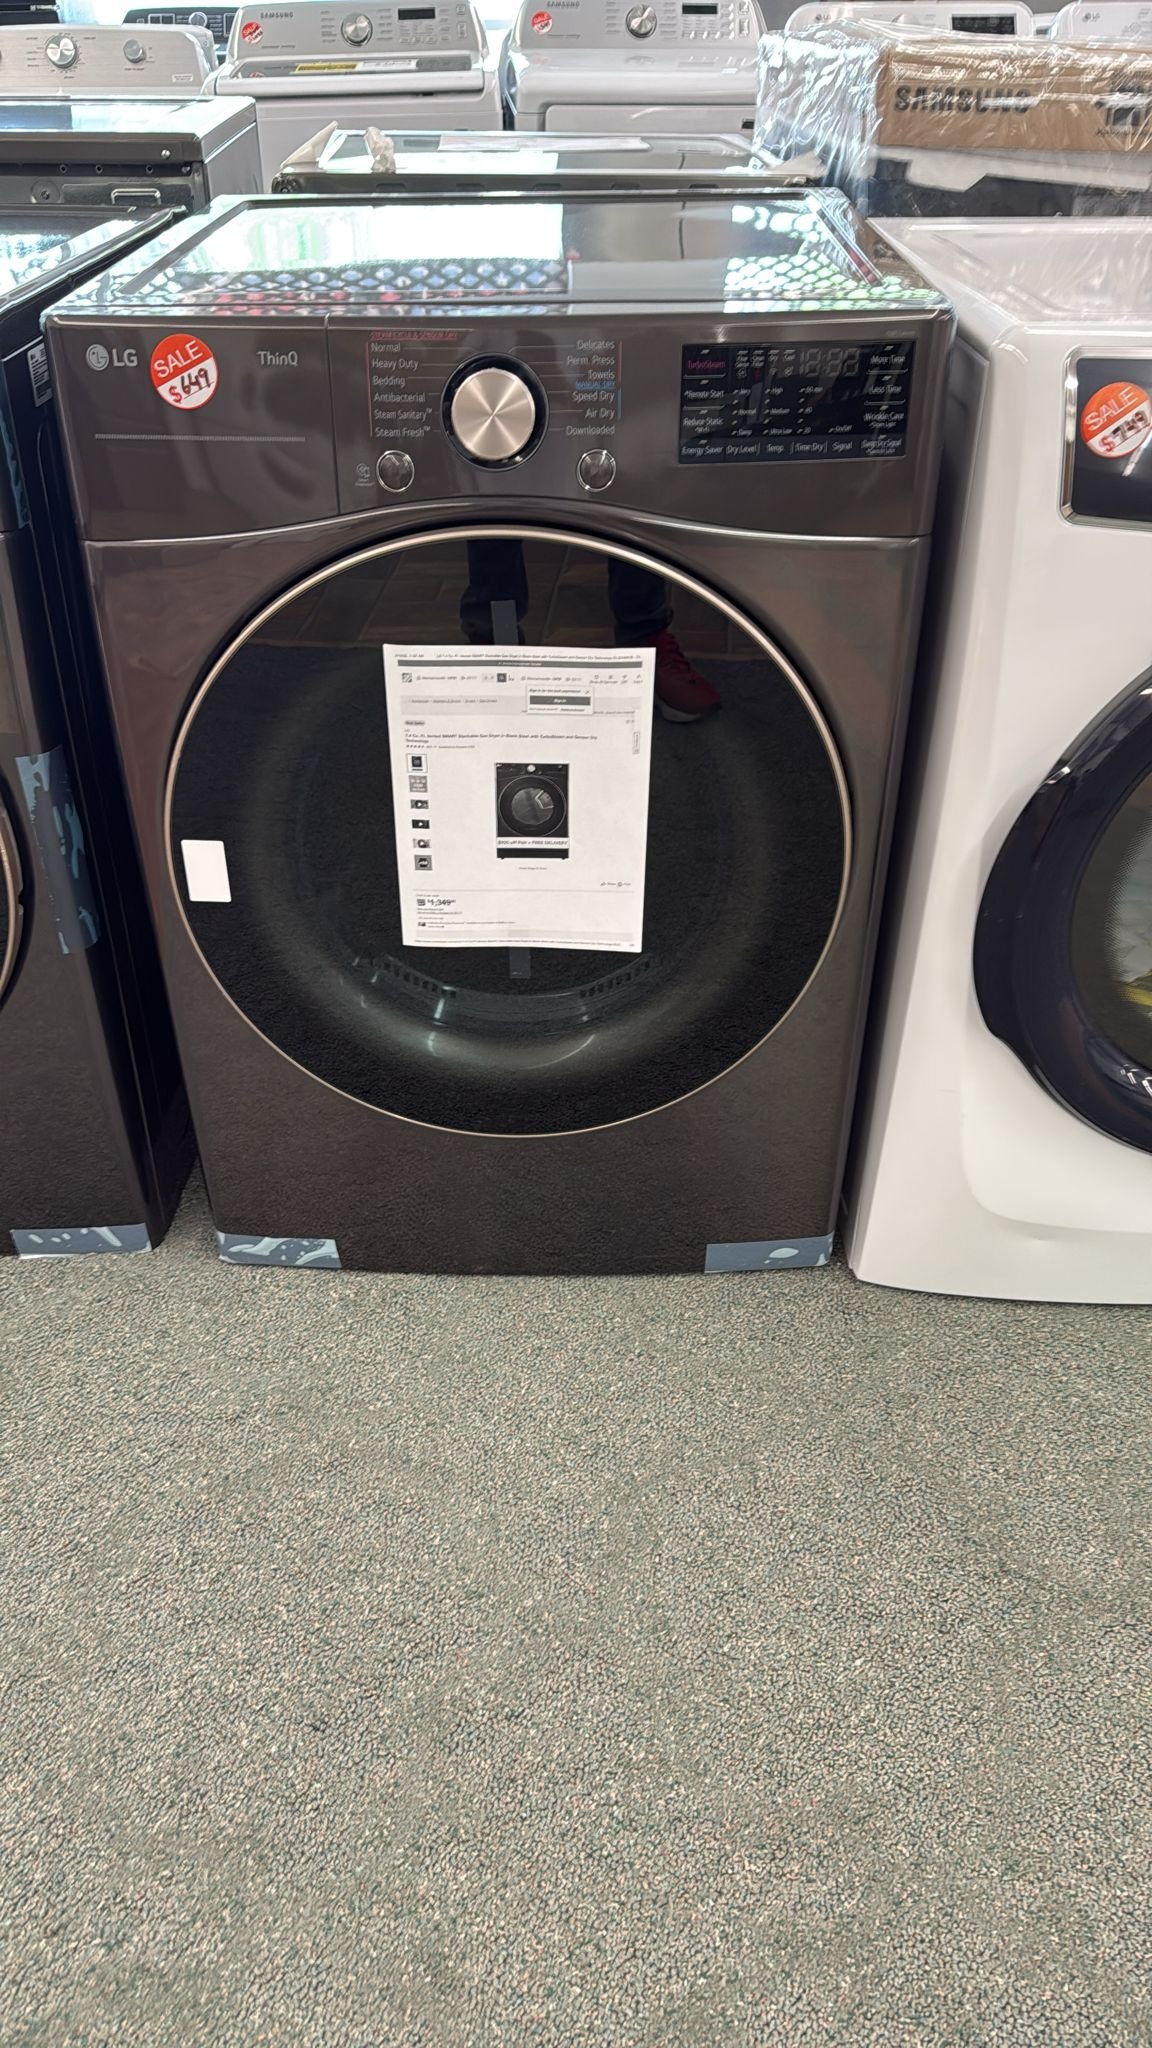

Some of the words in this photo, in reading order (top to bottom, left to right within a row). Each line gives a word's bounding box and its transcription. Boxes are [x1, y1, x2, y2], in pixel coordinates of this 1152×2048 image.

[896, 85, 1031, 113] SAMSUNG
[370, 343, 401, 352] Normal
[576, 340, 615, 350] Delicates
[112, 349, 138, 367] LG
[153, 340, 204, 379] SALE
[257, 350, 299, 367] ThinQ
[592, 355, 615, 365] Press
[372, 359, 397, 370] Heavy
[399, 358, 418, 371] Duty
[688, 360, 726, 369] TurboSteam
[588, 370, 615, 380] Towels
[168, 368, 211, 404] $649
[372, 376, 406, 388] Bedding
[374, 392, 426, 402] Antibacterial
[572, 390, 598, 404] Speed
[600, 390, 614, 403] Dry
[374, 409, 396, 419] Steam
[585, 408, 598, 418] Air
[600, 408, 615, 420] Dry
[1085, 386, 1139, 431] SALE
[376, 427, 400, 437] Steam
[566, 425, 616, 436] Downloaded
[682, 446, 704, 456] Energy
[706, 446, 724, 454] Saver
[726, 445, 738, 456] Dry
[740, 444, 756, 453] Level
